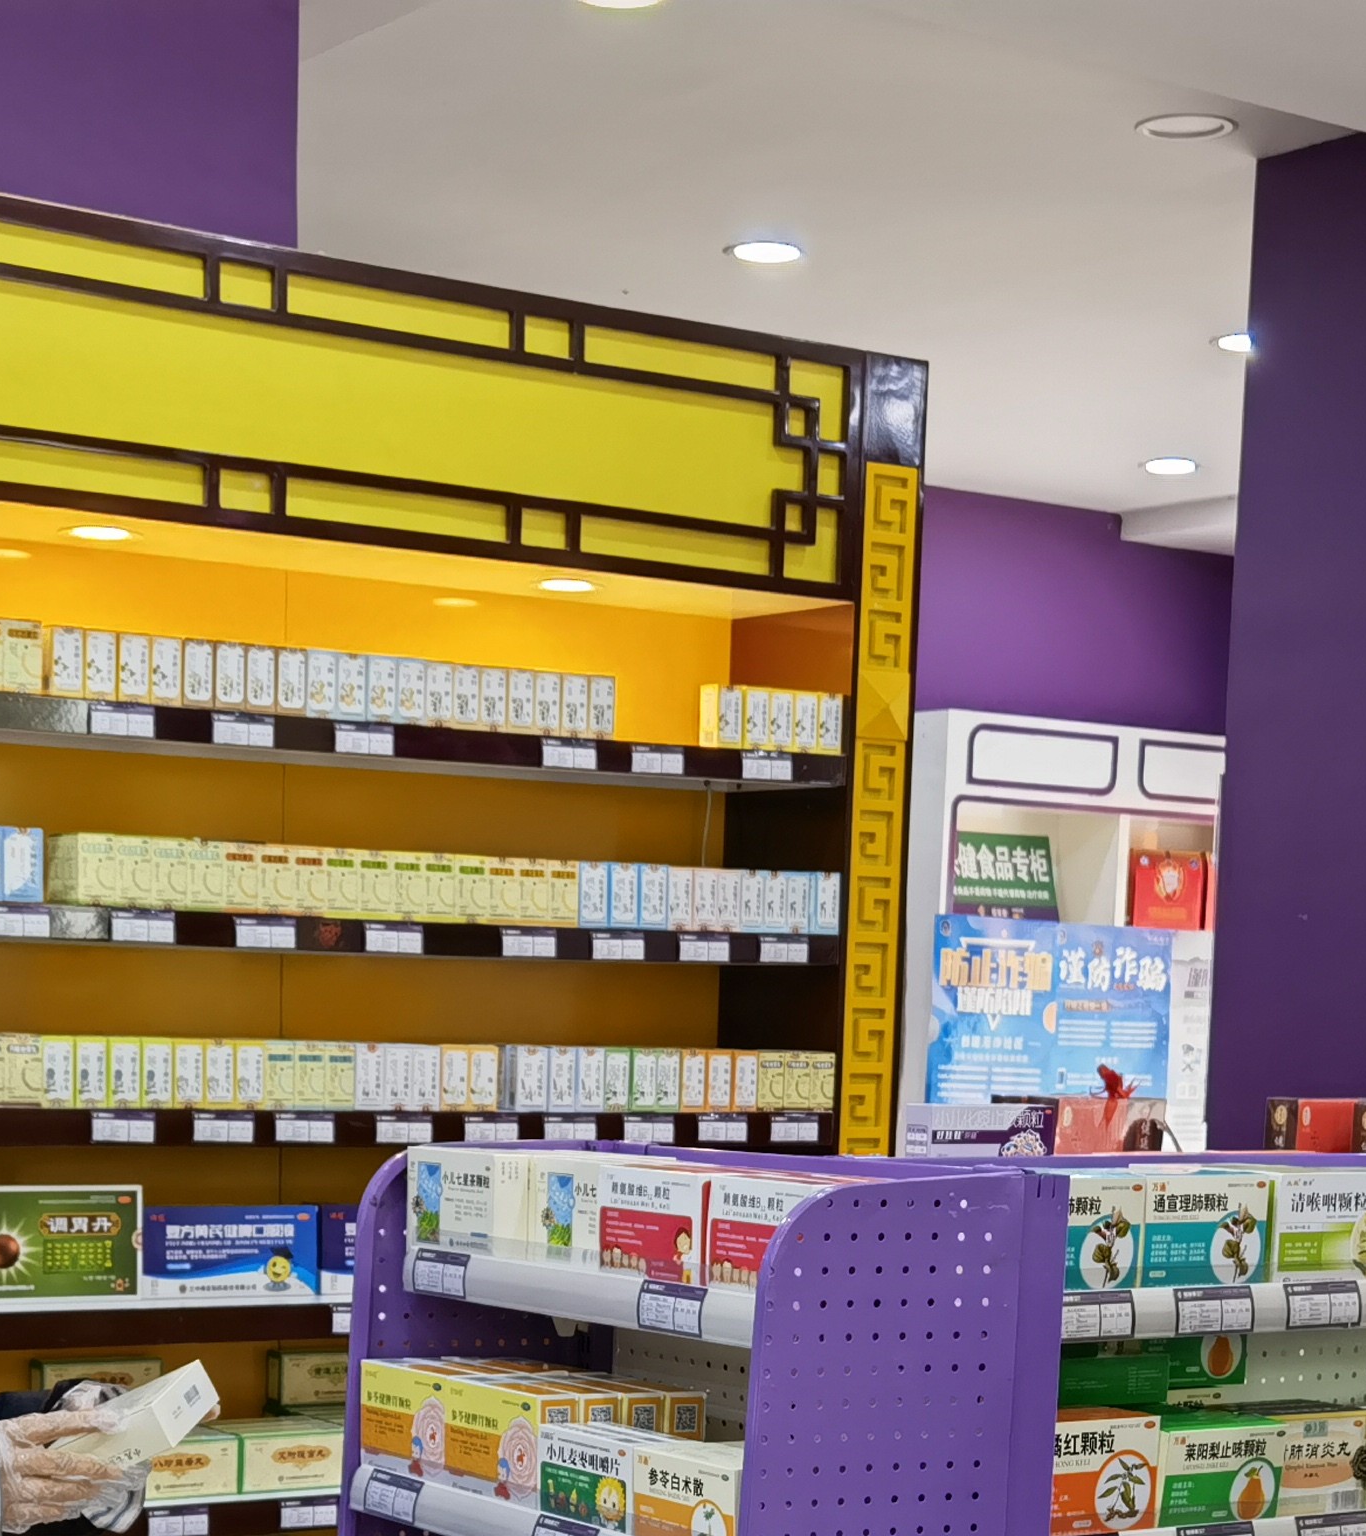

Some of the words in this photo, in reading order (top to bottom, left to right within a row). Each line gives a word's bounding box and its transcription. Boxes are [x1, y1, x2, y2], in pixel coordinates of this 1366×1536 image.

[954, 843, 1050, 883] 健食品专柜
[939, 948, 1053, 991] 防止诈骗
[1059, 947, 1167, 992] 谨防诈骗
[442, 1170, 490, 1189] 小儿七星茶颗粒
[1153, 1192, 1229, 1214] 通宣理肺颗粒
[49, 1216, 113, 1235] 调胃丹
[546, 1443, 621, 1477] 小儿麦枣咀嚼片
[1185, 1438, 1267, 1462] 莱阳梨止咳颗粒
[1283, 1440, 1352, 1463] 肺消炎丸
[648, 1467, 704, 1498] 参苓白术散
